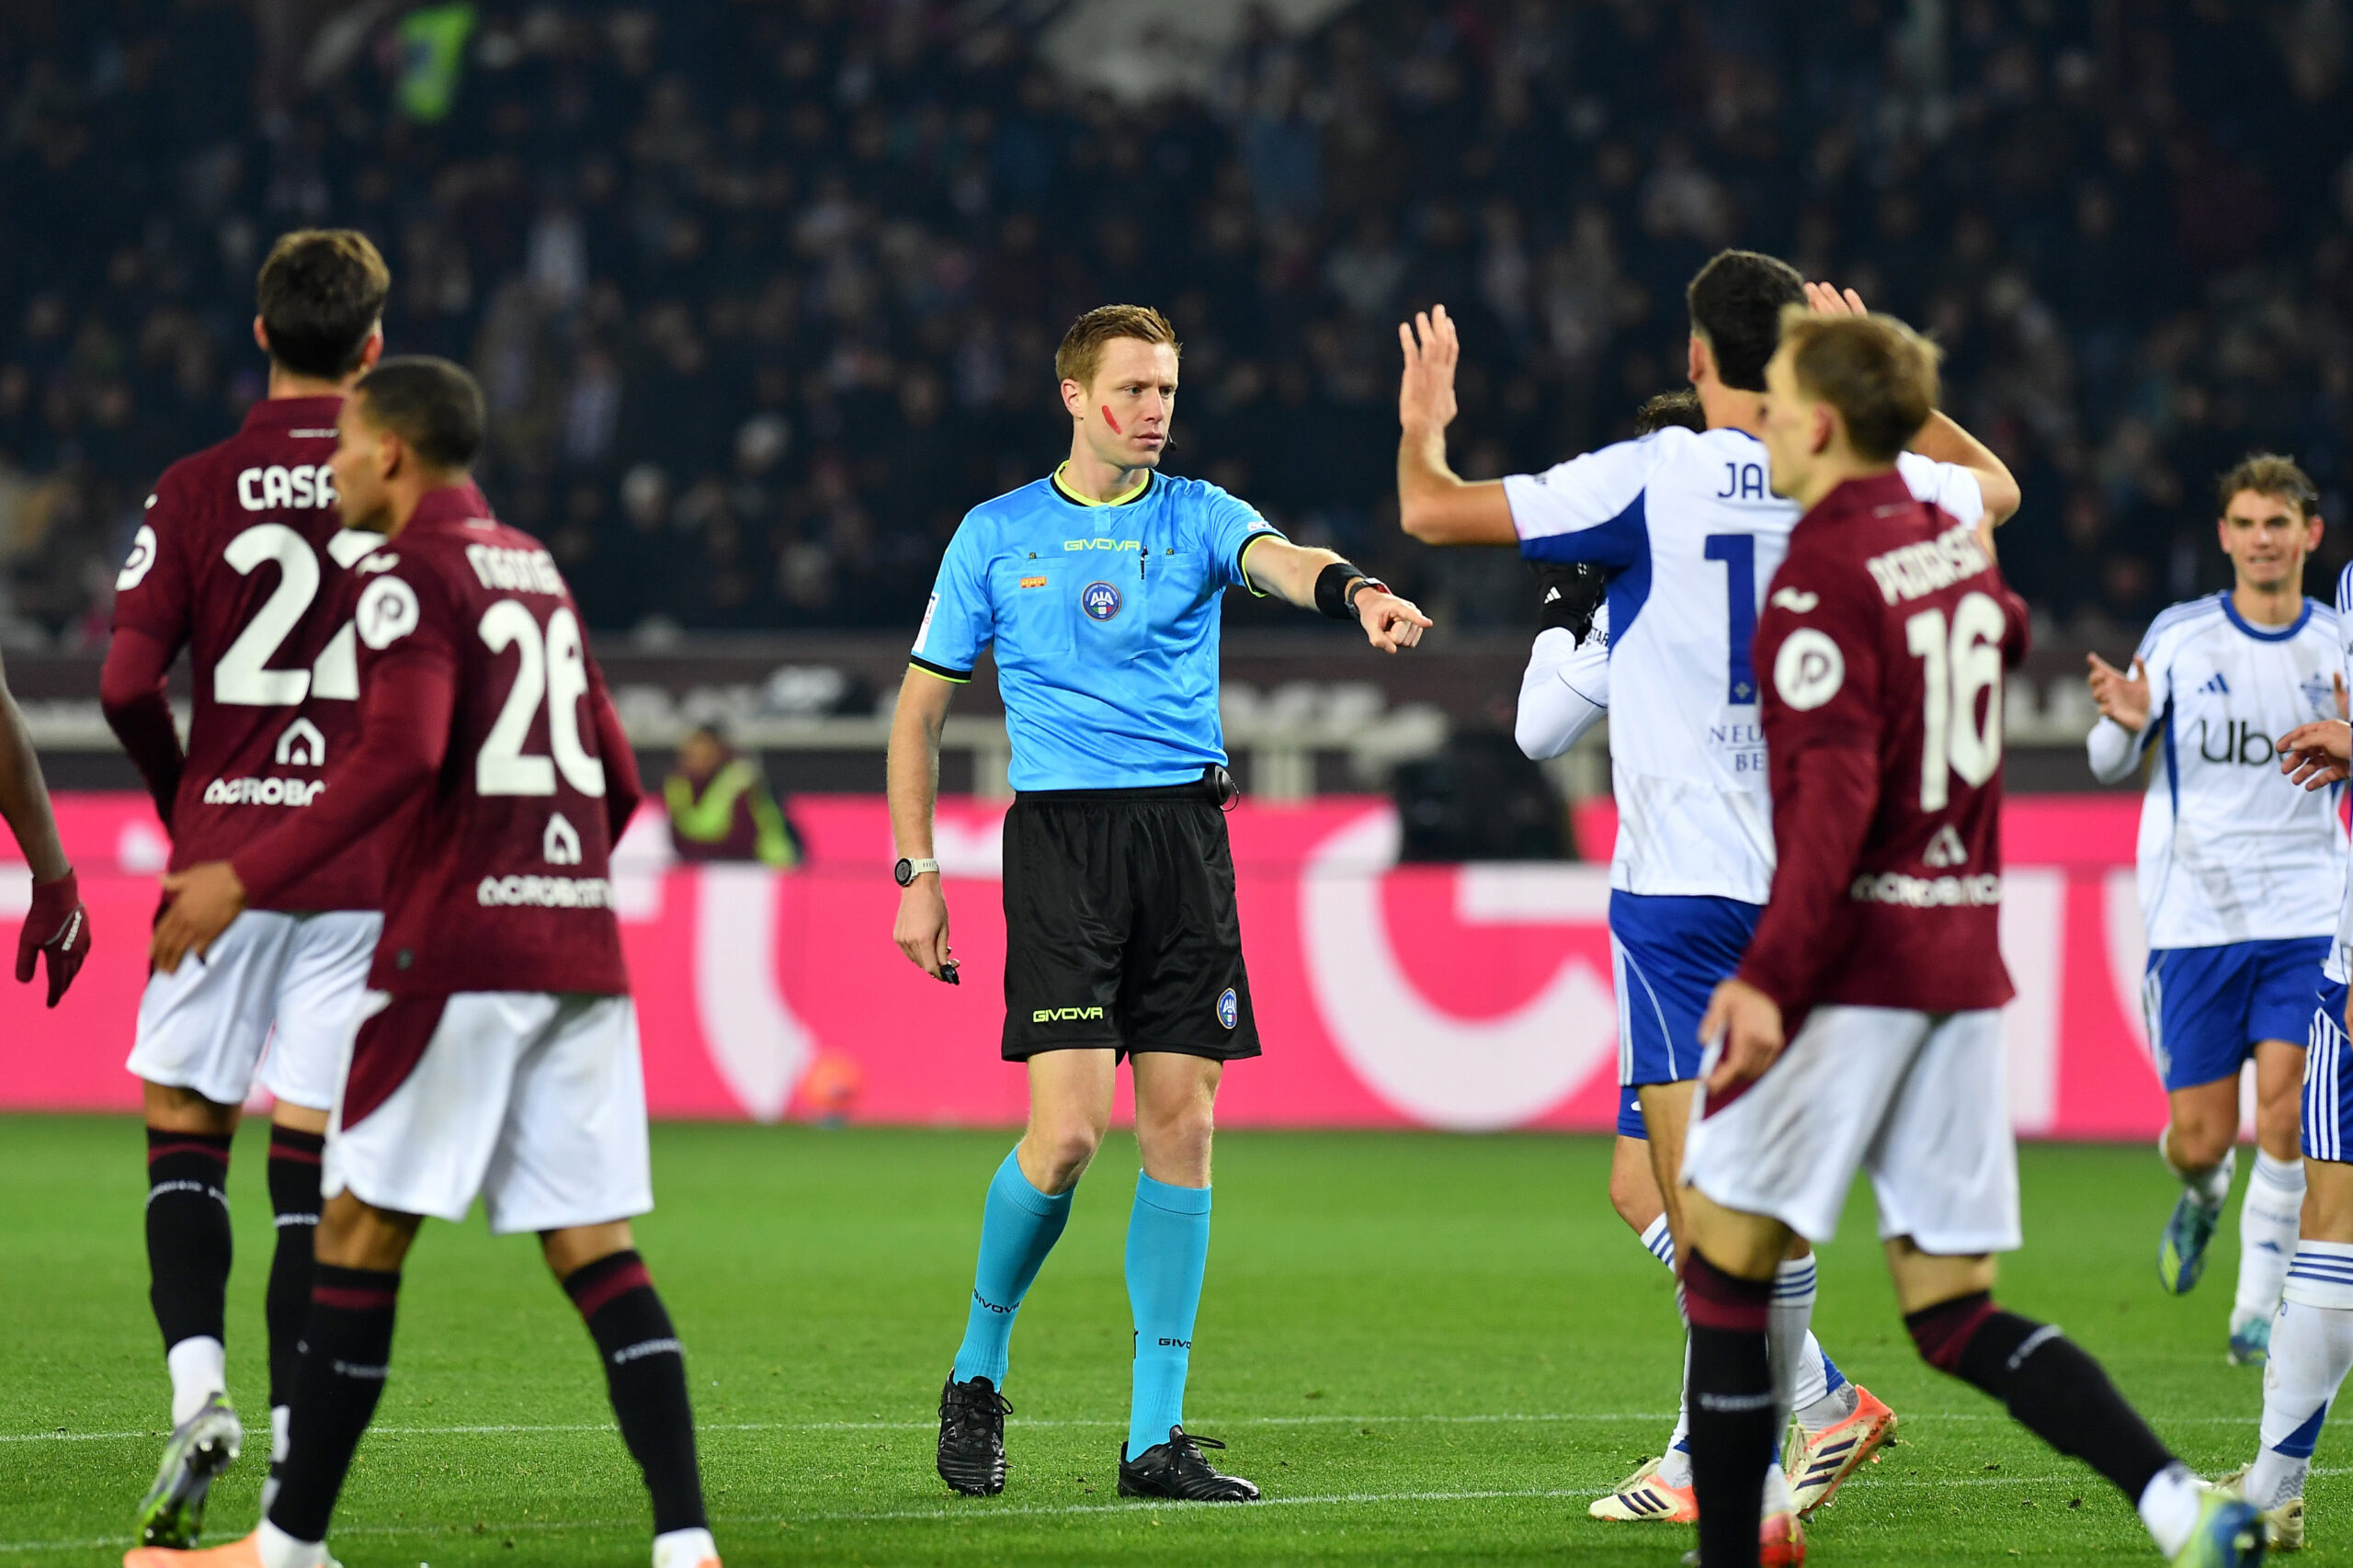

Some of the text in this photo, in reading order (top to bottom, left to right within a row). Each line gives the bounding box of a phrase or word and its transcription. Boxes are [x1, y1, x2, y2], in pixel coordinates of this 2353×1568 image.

[1063, 537, 1141, 552] GIVOVA
[1089, 590, 1115, 607] AIA
[475, 599, 608, 799] 26
[1904, 591, 2007, 813] 16
[1709, 724, 1765, 744] NEU
[1032, 1006, 1104, 1023] GIVOVA
